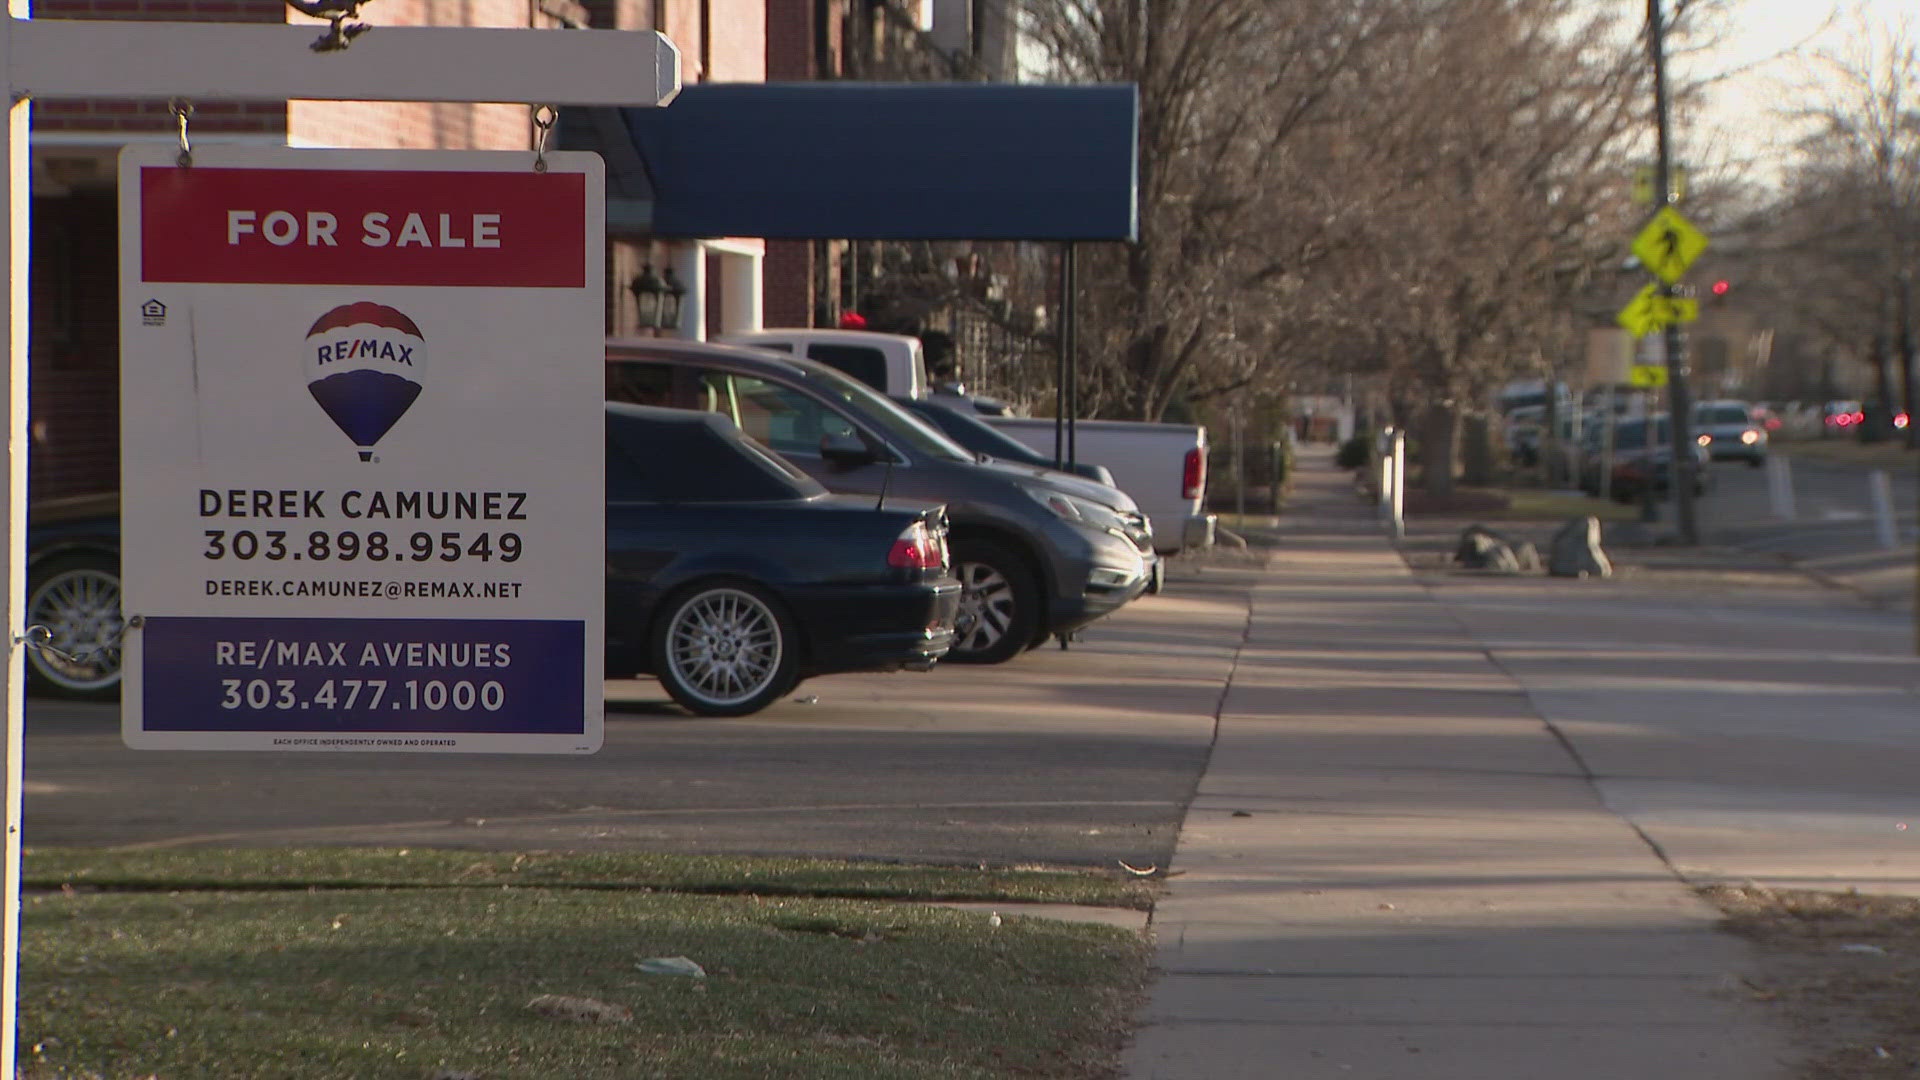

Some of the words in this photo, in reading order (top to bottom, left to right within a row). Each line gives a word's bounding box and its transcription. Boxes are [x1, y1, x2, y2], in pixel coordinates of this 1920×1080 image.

[227, 211, 338, 246] FOR
[361, 213, 501, 248] SALE
[318, 339, 414, 366] RE/MAX
[200, 489, 325, 518] DEREK
[341, 491, 528, 520] CAMUNEZ
[203, 530, 523, 562] 303.898.9549
[206, 580, 522, 600] DEREK.CAMUNEZ@REMAX.NET
[216, 639, 347, 670] RE/MAX
[359, 643, 511, 668] AVENUES
[221, 679, 505, 712] 303.477.1000
[273, 738, 292, 746] EACH
[293, 738, 318, 746] OFFICE
[319, 738, 375, 746] INDEPENDENTLY
[376, 738, 403, 747] OWNED
[404, 739, 420, 747] AND
[420, 739, 457, 747] OPERATED
